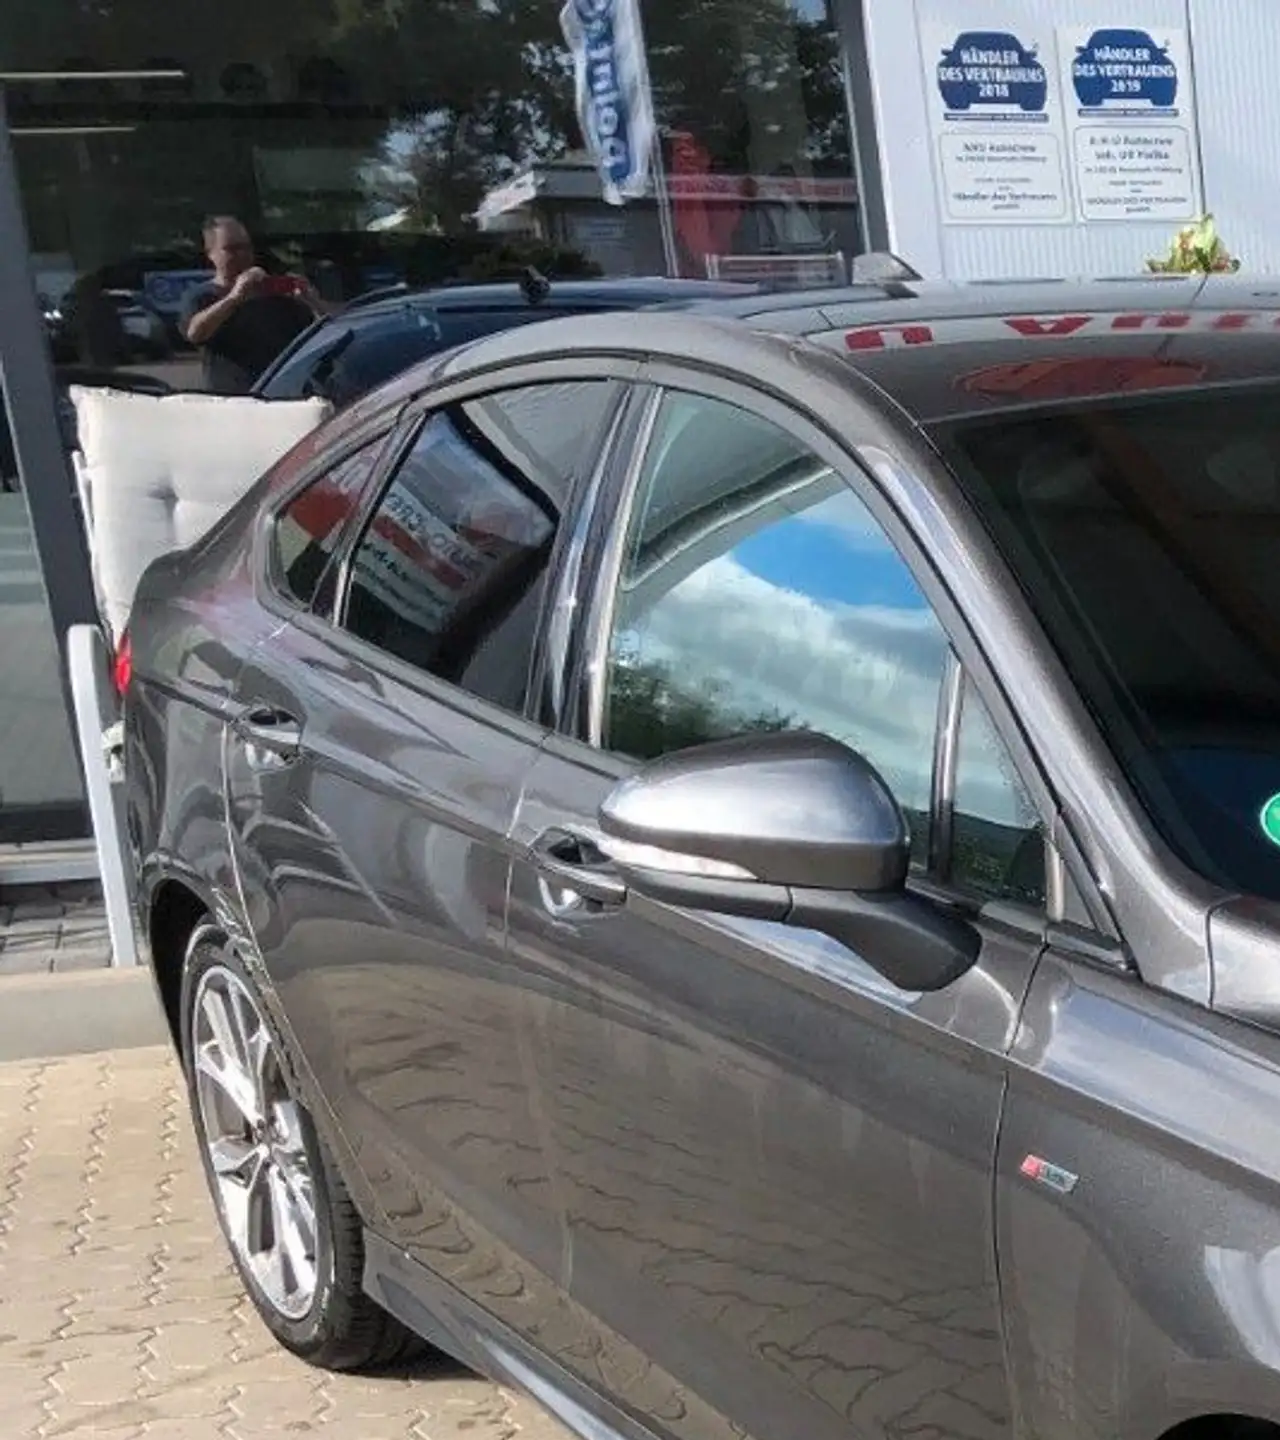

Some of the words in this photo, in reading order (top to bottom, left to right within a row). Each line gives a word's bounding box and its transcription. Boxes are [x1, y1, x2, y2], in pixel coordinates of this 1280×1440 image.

[960, 47, 1019, 65] HÄNDLER
[1093, 45, 1150, 61] HÄNDLER
[940, 66, 964, 81] DES
[965, 67, 1044, 82] VERTRAUENS
[1074, 63, 1096, 77] DES
[1097, 64, 1176, 78] VERTRAUENS
